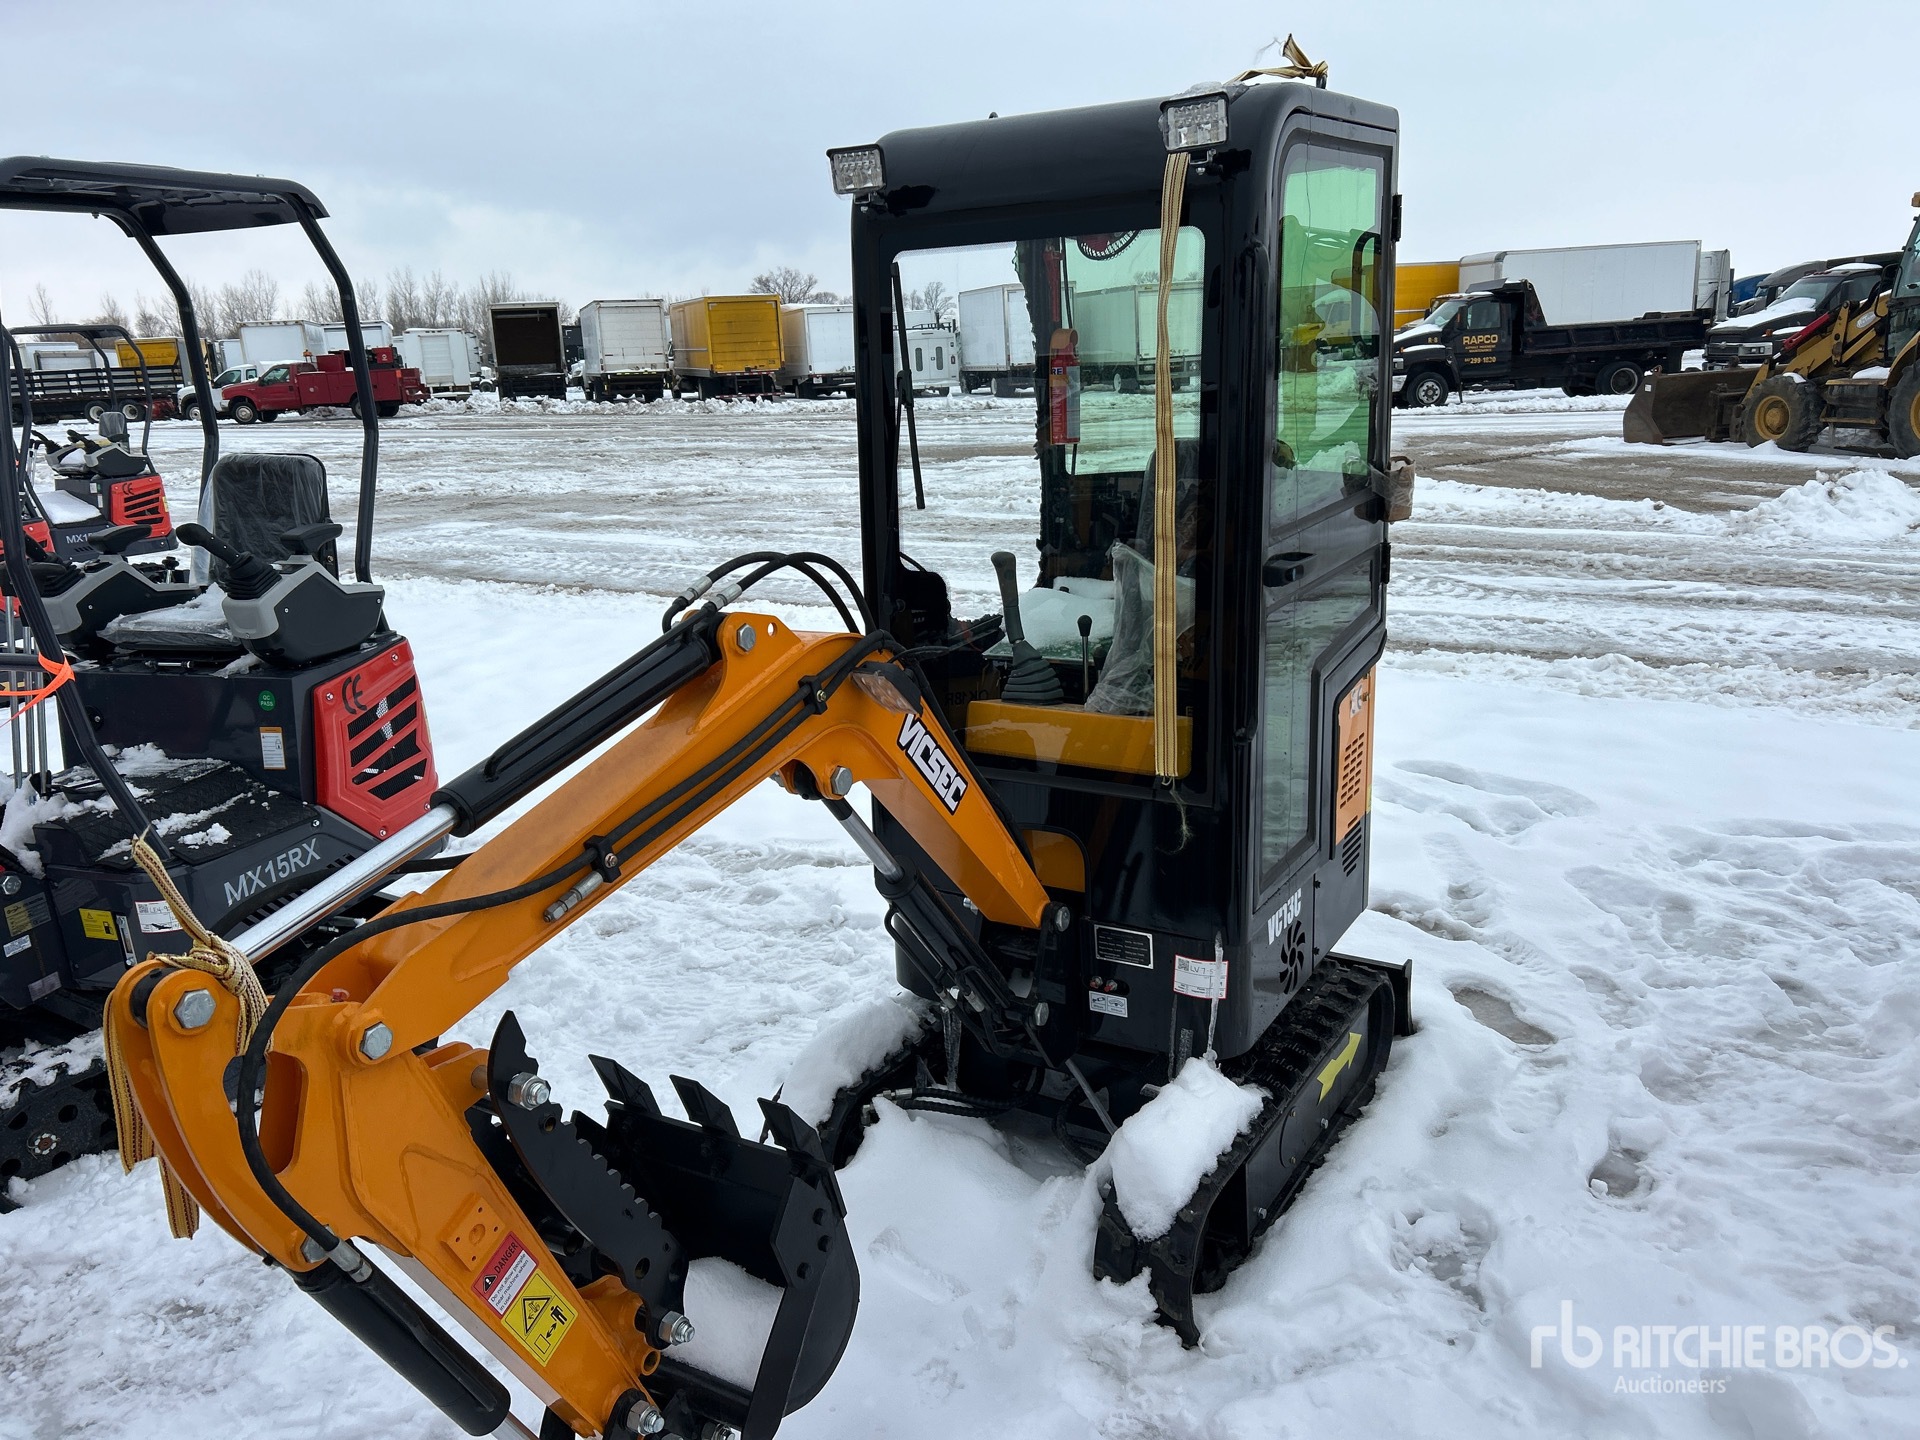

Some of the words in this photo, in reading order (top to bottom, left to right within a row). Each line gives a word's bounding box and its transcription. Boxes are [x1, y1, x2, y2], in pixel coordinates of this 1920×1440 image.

[1463, 334, 1498, 345] RAPCO
[66, 533, 92, 544] MX1
[898, 713, 968, 813] VICSEC
[223, 837, 321, 907] MX15RX
[1268, 887, 1302, 946] VC13C
[491, 1294, 498, 1302] Do
[504, 1272, 514, 1284] allow
[512, 1253, 526, 1272] people
[494, 1242, 518, 1274] DANGER
[496, 1295, 505, 1307] near
[503, 1274, 519, 1294] machine
[518, 1259, 529, 1274] when
